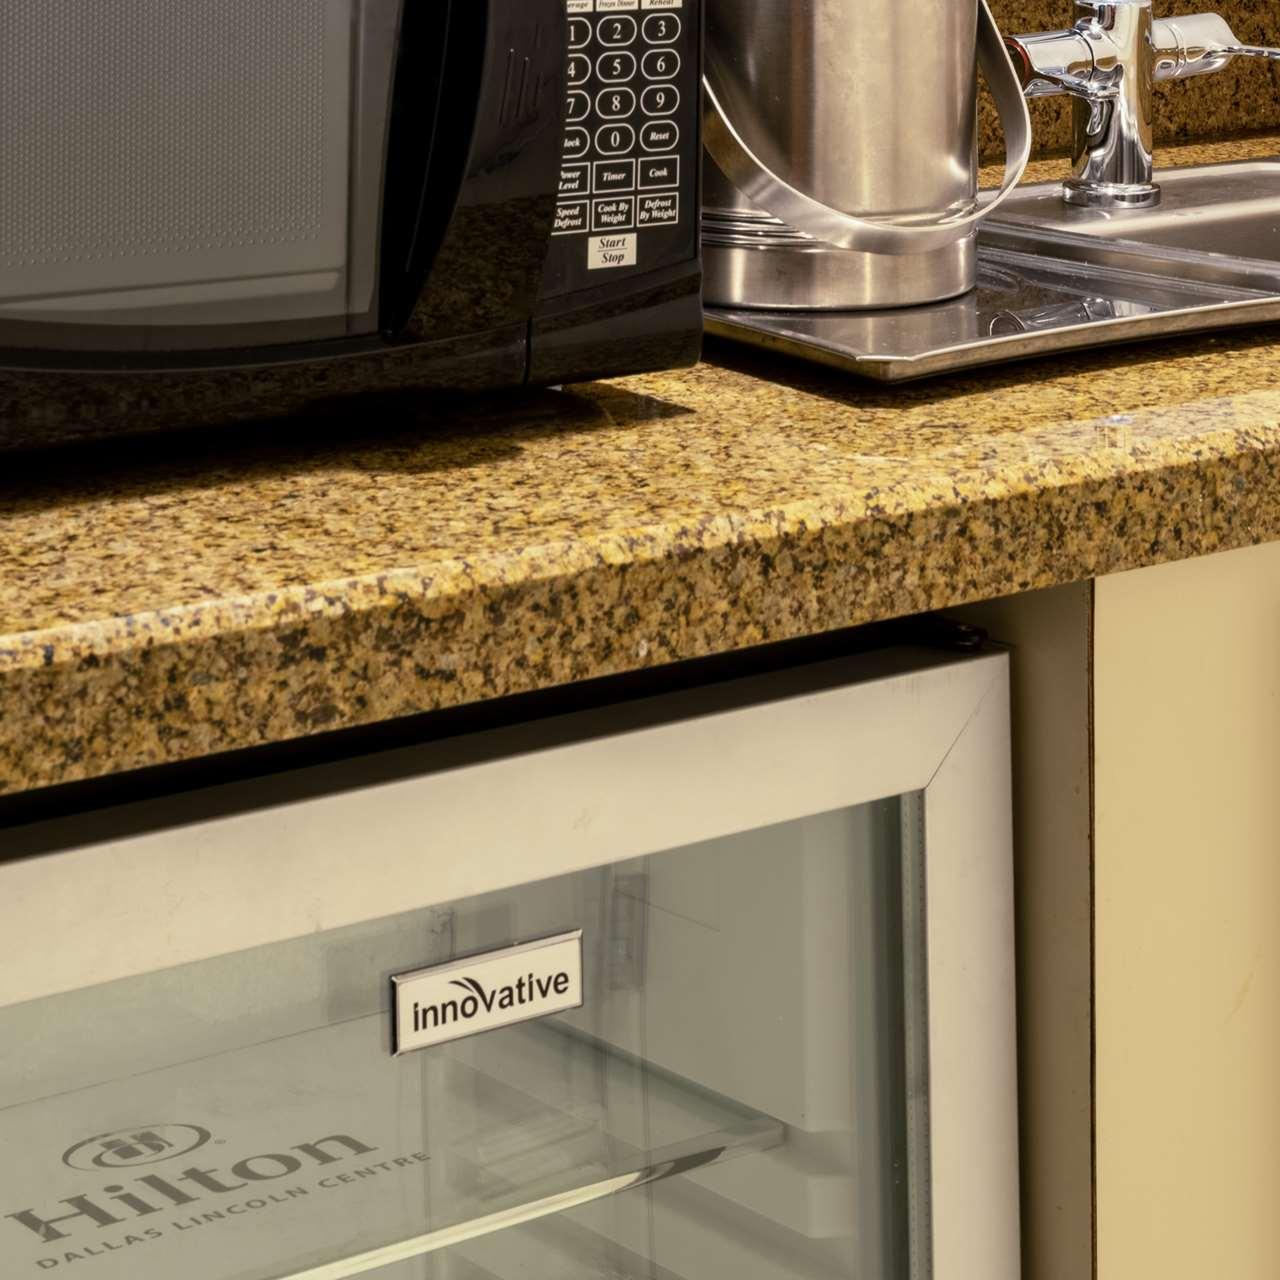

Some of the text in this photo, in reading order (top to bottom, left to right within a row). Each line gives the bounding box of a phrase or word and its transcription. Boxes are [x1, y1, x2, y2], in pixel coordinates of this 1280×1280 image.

[570, 25, 576, 41] 1
[612, 23, 622, 39] 2
[657, 20, 666, 37] 3
[567, 61, 576, 78] 4
[612, 58, 621, 75] 5
[656, 56, 665, 73] 6
[566, 98, 576, 114] 7
[611, 95, 621, 112] 8
[655, 91, 665, 108] 9
[564, 138, 580, 148] lock
[610, 131, 620, 148] 0
[650, 132, 669, 140] Reset
[602, 172, 626, 181] Timer
[649, 167, 668, 178] Cook
[558, 180, 579, 191] Level
[598, 202, 629, 213] Cook By
[644, 199, 672, 209] Defrost
[556, 206, 580, 218] Speed
[600, 214, 626, 224] Weight
[640, 209, 676, 221] By Weight
[553, 217, 582, 229] Defrost
[599, 238, 626, 248] Start
[601, 252, 625, 264] Stop
[413, 972, 569, 1033] innovative
[4, 1131, 381, 1244] Hilton
[35, 1150, 433, 1270] DALLAS LINCOLN CENTRE
